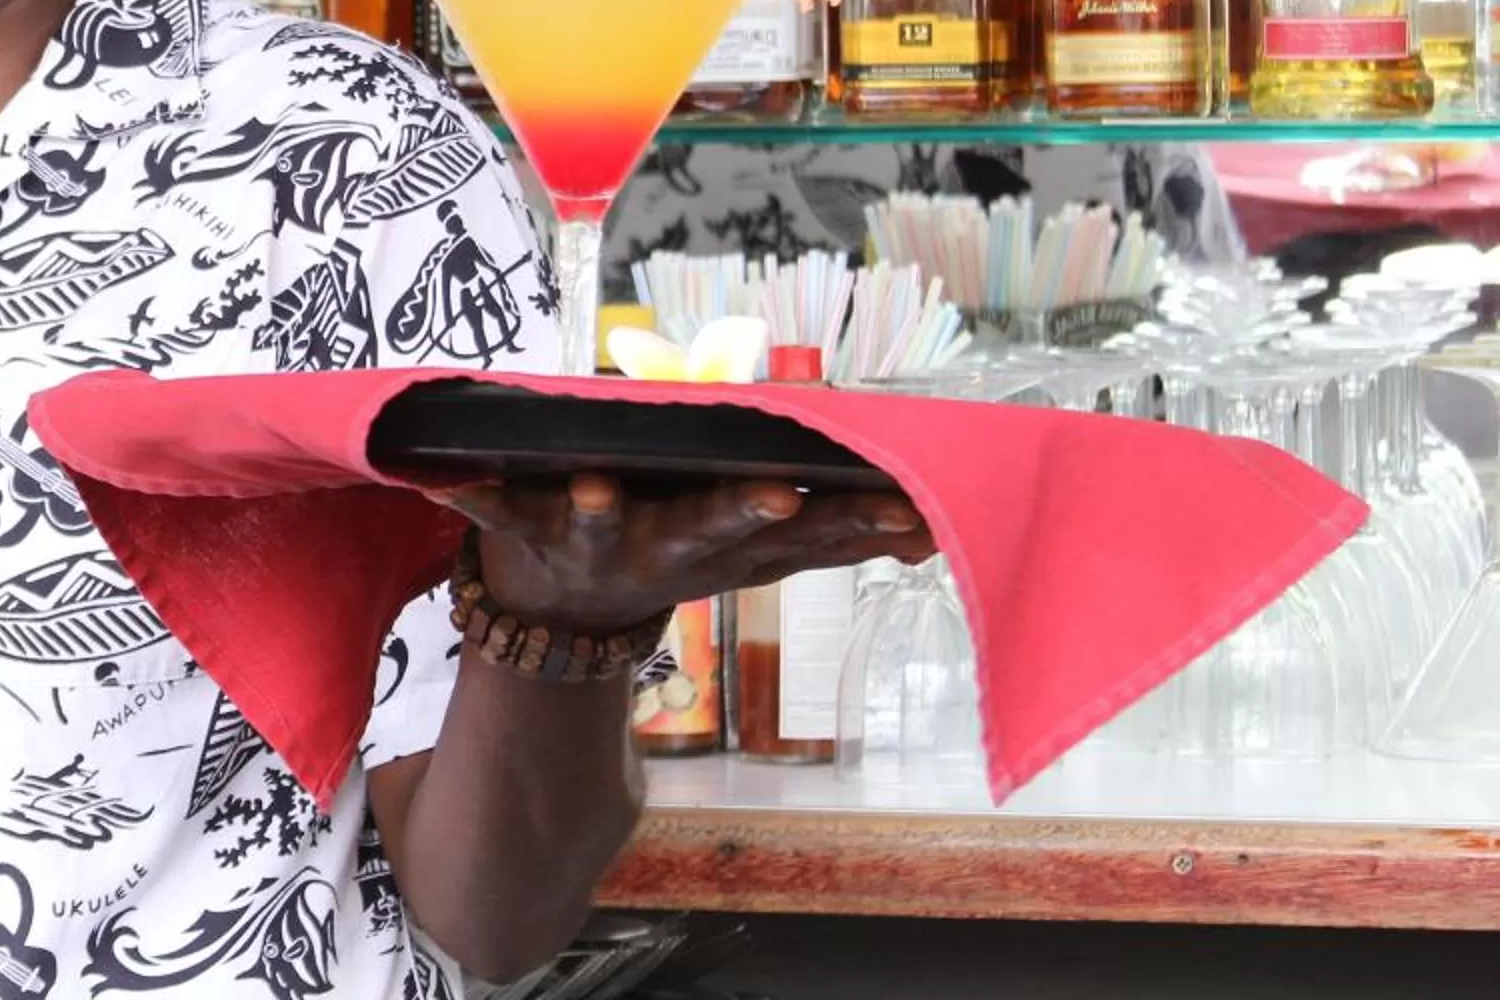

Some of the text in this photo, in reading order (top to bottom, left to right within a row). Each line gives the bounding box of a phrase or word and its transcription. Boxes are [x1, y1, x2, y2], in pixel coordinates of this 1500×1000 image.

[902, 23, 929, 42] 12
[91, 680, 170, 741] AWAPU
[51, 861, 150, 919] UKULELE
